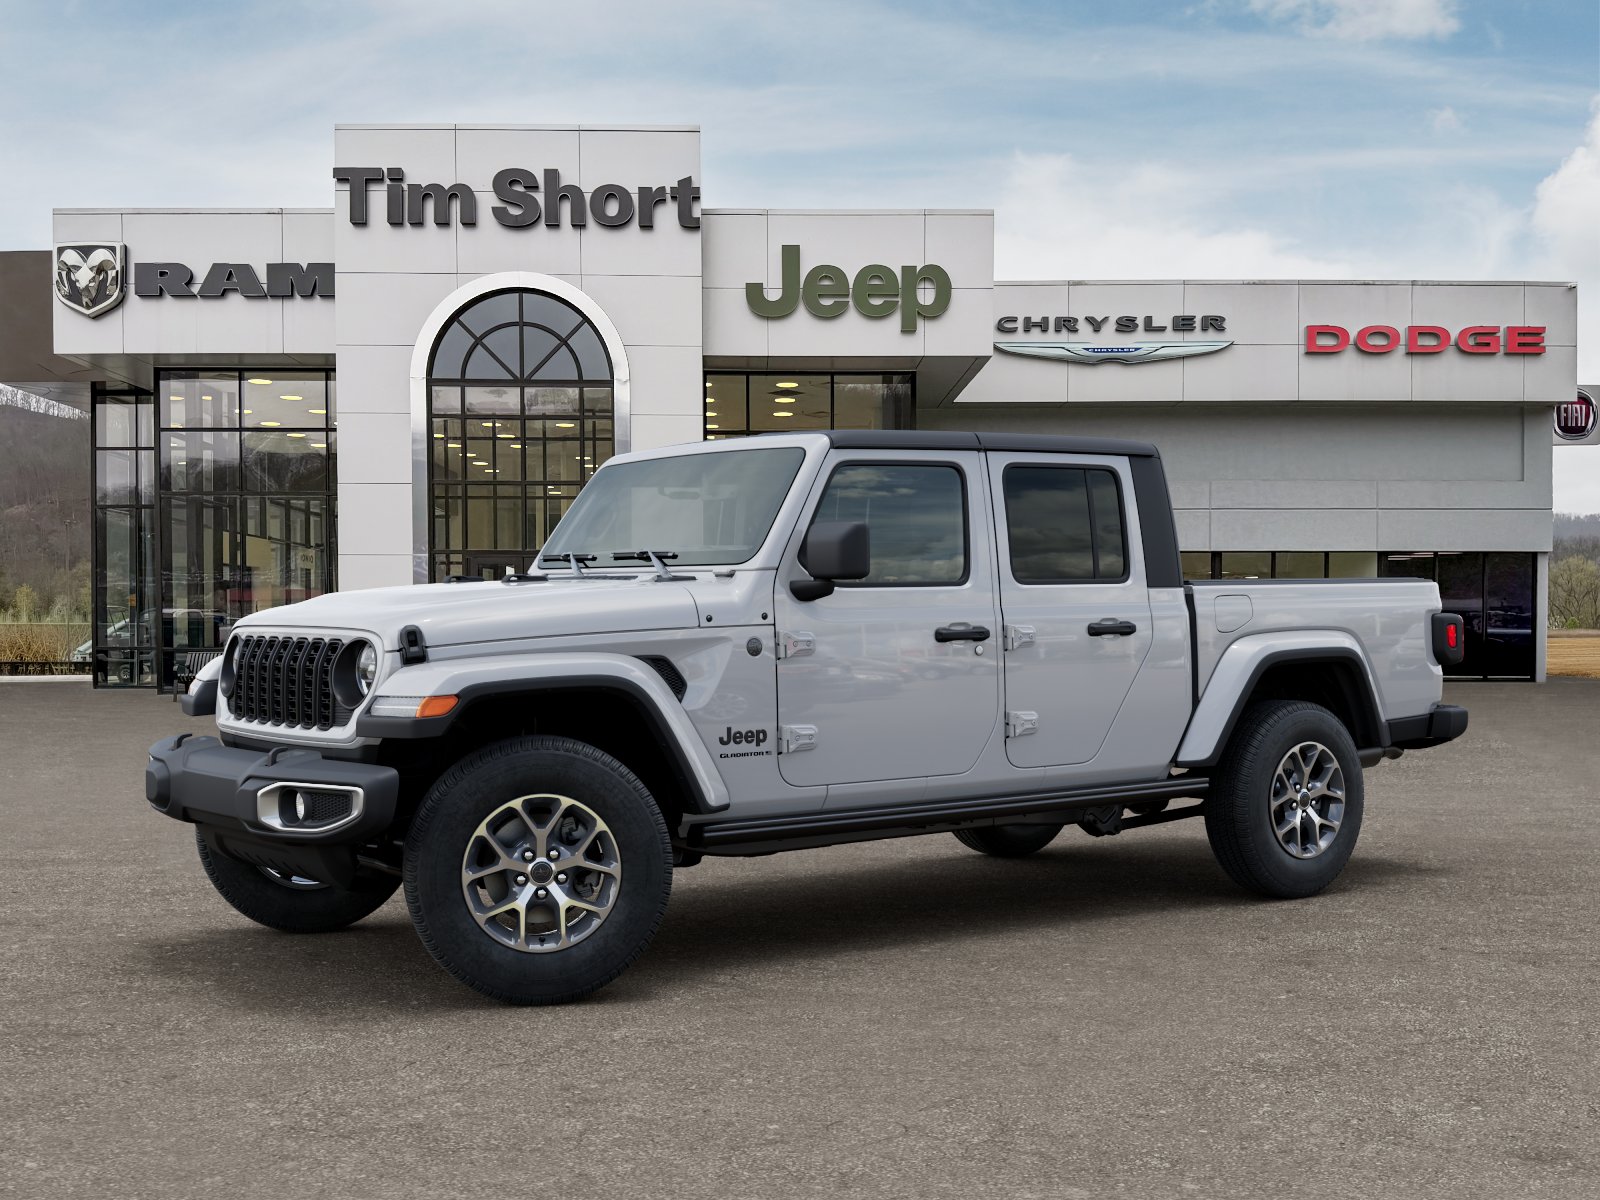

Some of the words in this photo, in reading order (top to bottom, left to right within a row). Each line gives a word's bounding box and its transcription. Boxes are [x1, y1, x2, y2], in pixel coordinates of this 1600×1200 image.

[333, 168, 476, 227] Tim
[491, 168, 701, 229] Short
[134, 262, 335, 299] RAM
[745, 244, 952, 333] Jeep
[997, 315, 1227, 333] CHRYSLER
[1304, 325, 1547, 355] DODGE
[1560, 404, 1586, 427] FIAT
[718, 726, 768, 747] Jeep
[719, 751, 765, 759] GLADIATOR
